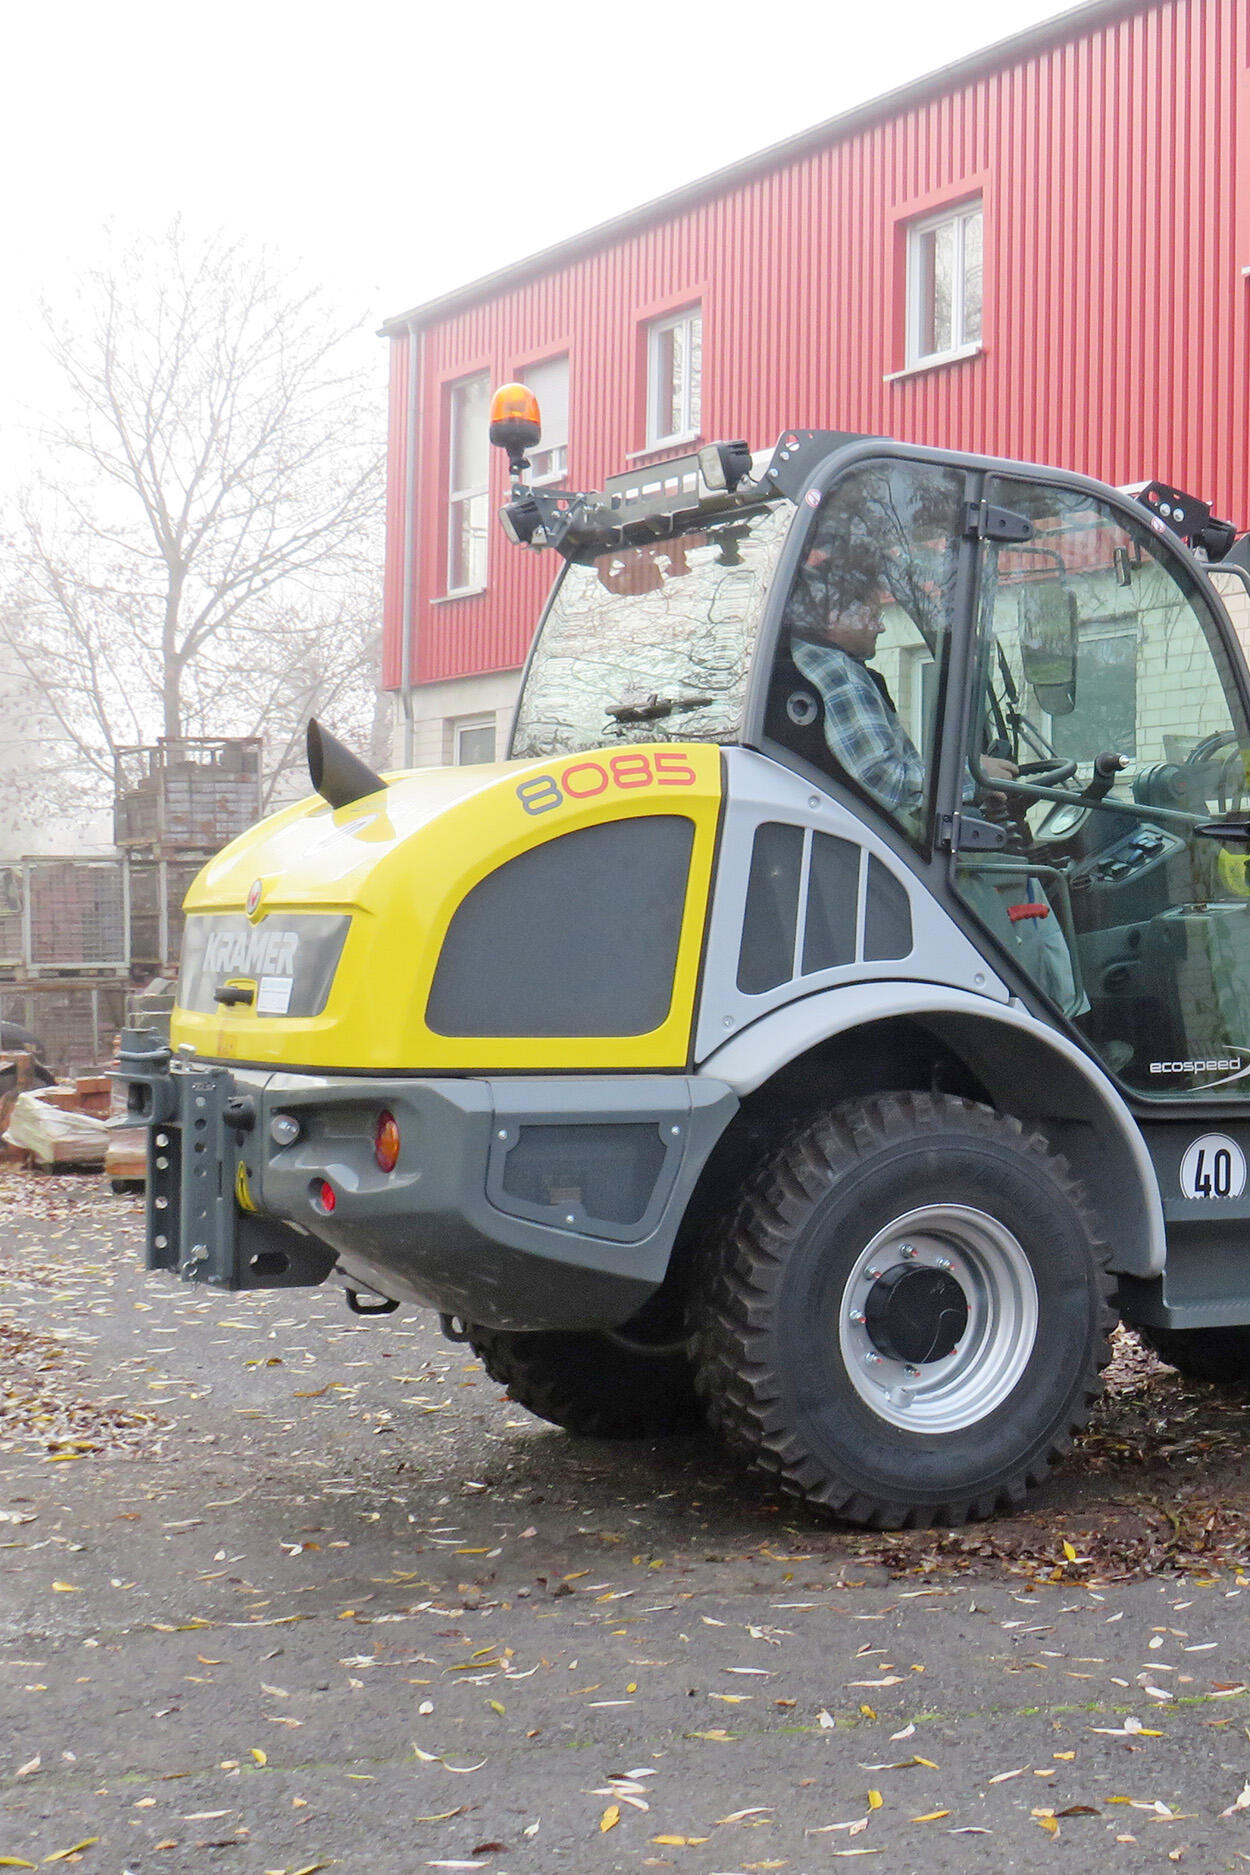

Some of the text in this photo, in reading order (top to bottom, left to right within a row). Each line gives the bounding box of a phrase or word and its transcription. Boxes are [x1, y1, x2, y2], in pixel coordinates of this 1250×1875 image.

[516, 753, 696, 816] 8085
[203, 931, 299, 975] KRAMER
[1150, 1057, 1240, 1075] ecospeed
[1194, 1148, 1232, 1198] 40
